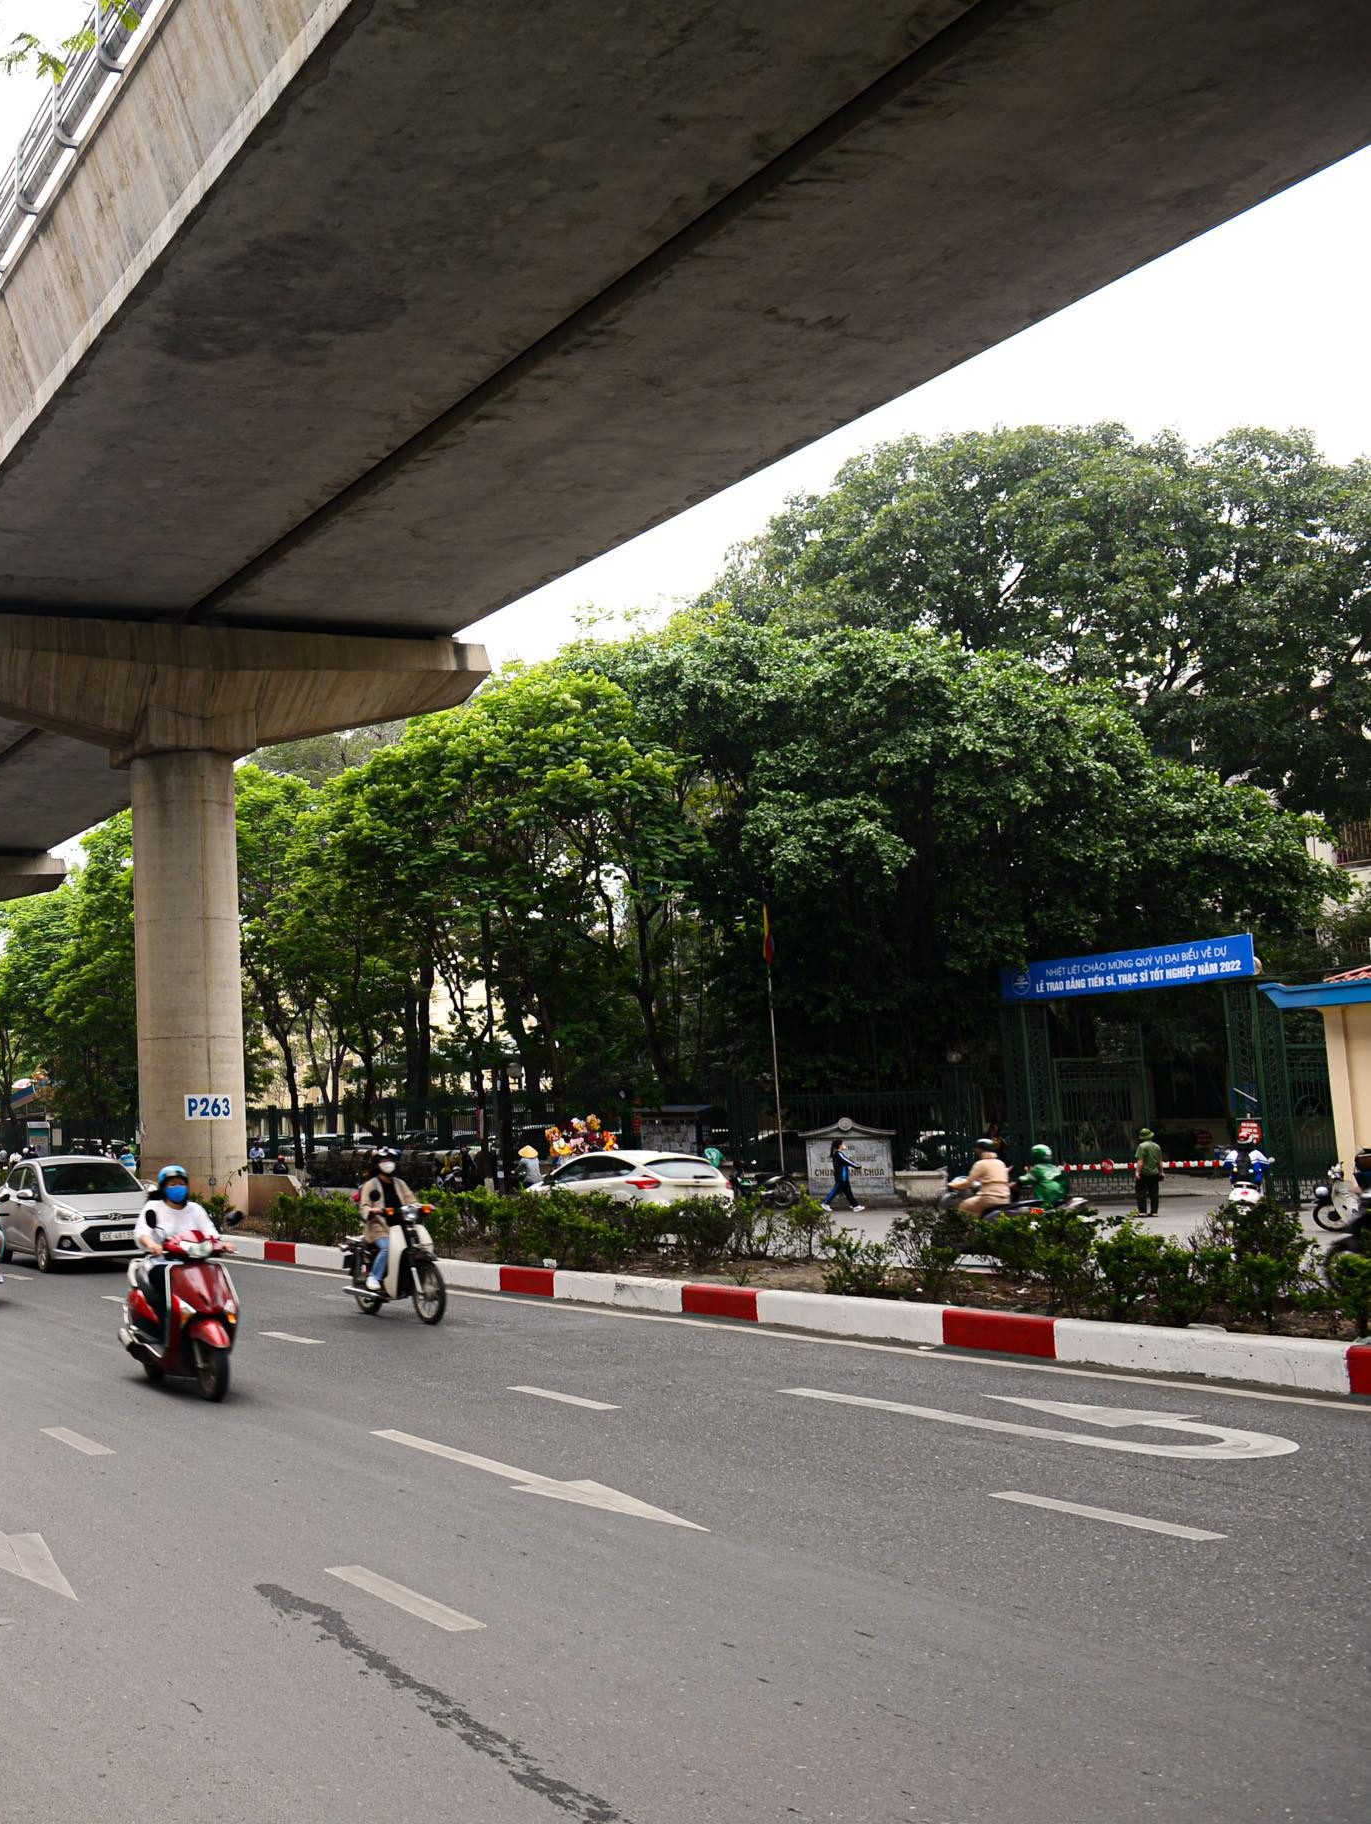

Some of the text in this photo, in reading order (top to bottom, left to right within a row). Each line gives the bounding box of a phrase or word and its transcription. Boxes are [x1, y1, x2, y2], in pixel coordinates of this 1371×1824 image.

[1035, 980, 1045, 993] LỄ
[1046, 980, 1064, 992] TRAO
[1065, 976, 1086, 990] BẰNG
[1087, 974, 1105, 988] TIẾN
[1117, 972, 1138, 986] THẠC
[1150, 966, 1164, 981] TỐT
[1165, 964, 1196, 980] NGHIỆP
[1197, 961, 1218, 976] NĂM
[1219, 959, 1242, 973] 2022
[1045, 945, 1227, 977] NHIỆT LIỆT CHÀO MỪNG QUÝ VỊ ĐẠI BIỂU VỀ DỰ
[187, 1097, 231, 1117] P263
